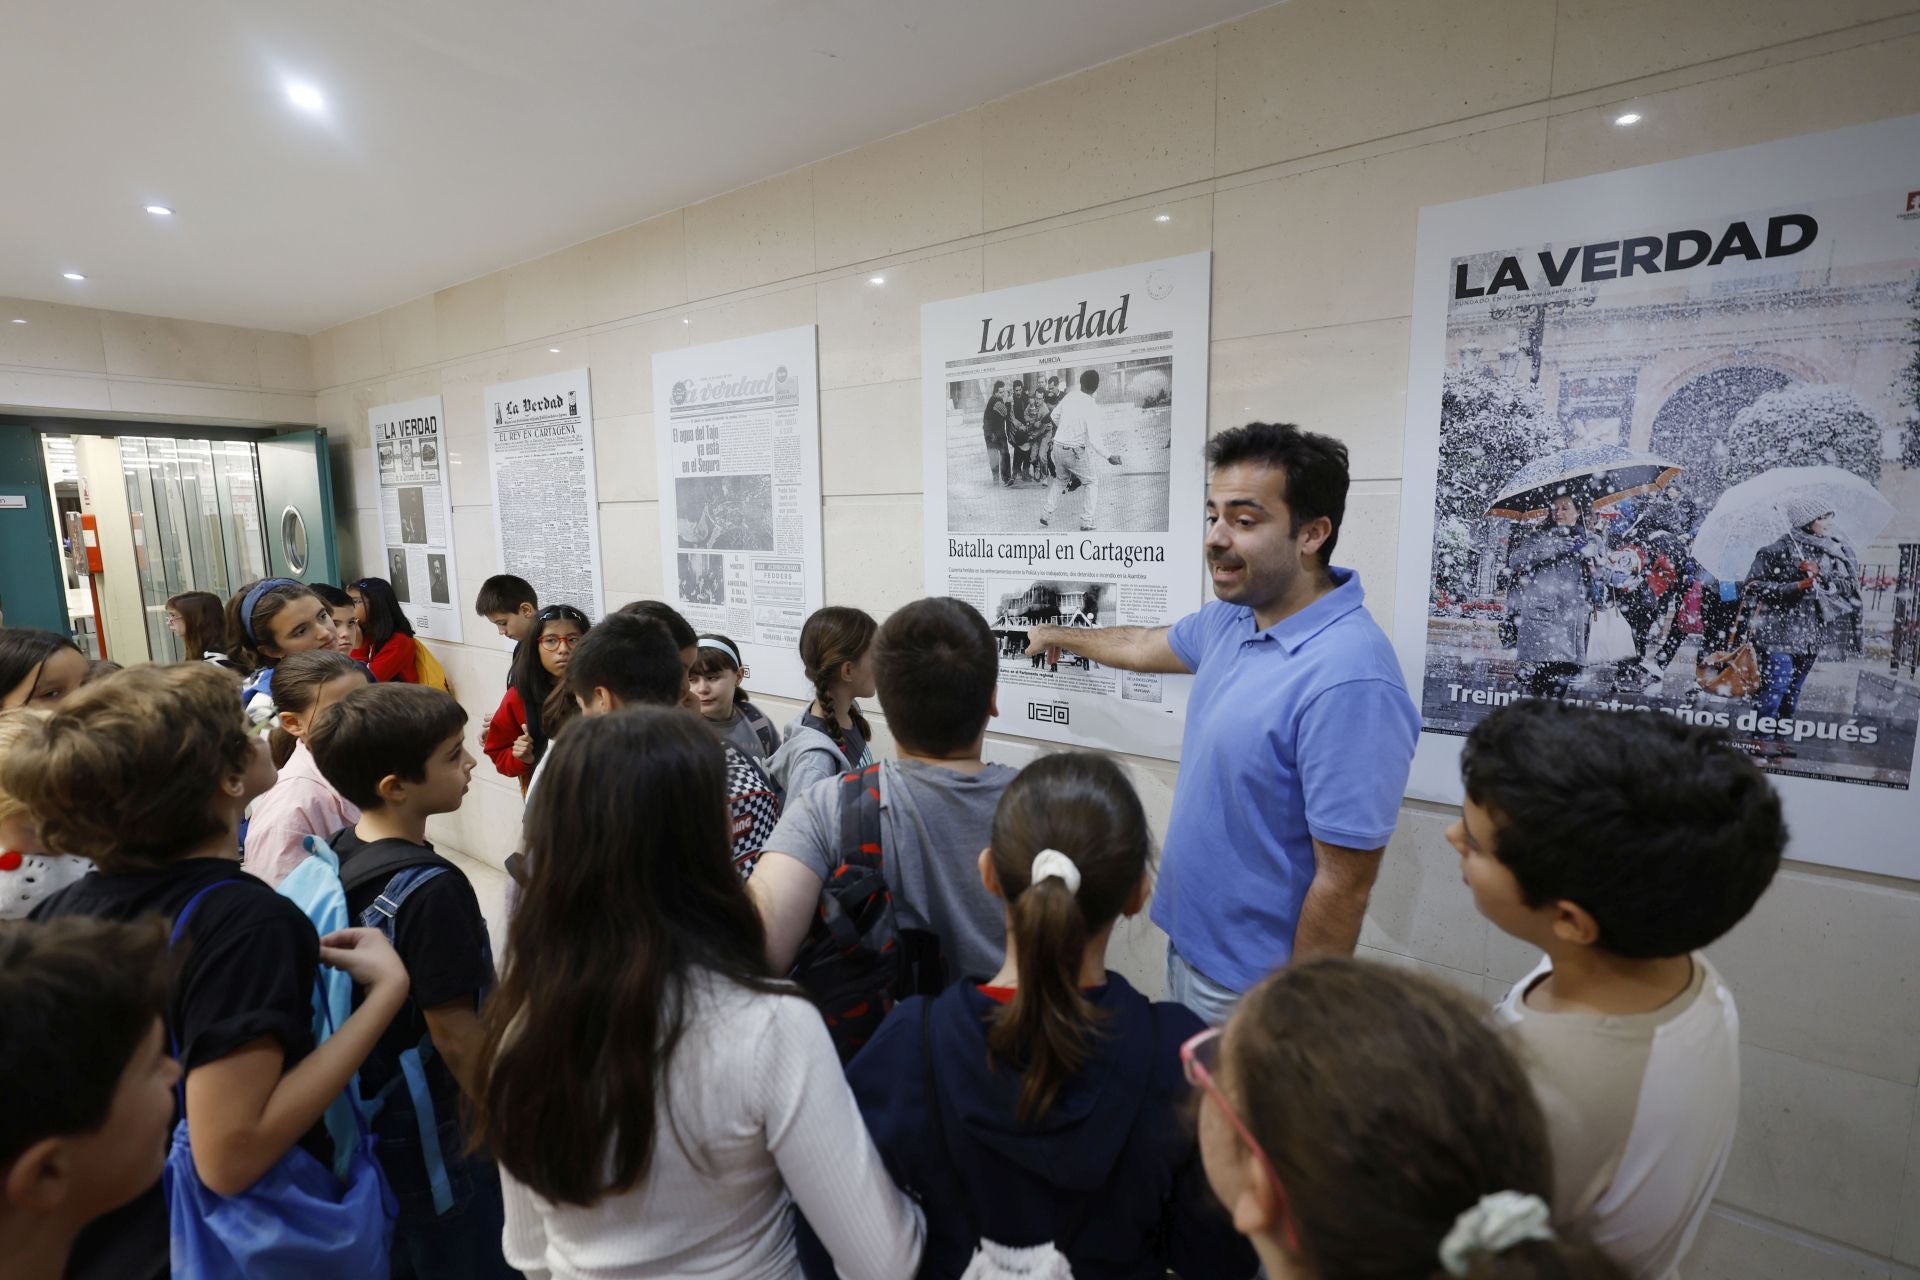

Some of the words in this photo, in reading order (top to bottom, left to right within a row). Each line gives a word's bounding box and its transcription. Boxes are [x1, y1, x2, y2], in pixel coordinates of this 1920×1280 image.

[1454, 256, 1529, 299] LA
[1537, 213, 1819, 288] VERDAD
[978, 317, 1015, 354] La
[1022, 293, 1130, 347] verdad
[1038, 356, 1061, 365] MURCIA
[700, 372, 774, 402] verdad
[506, 401, 519, 415] La
[523, 395, 564, 412] Verdad
[384, 421, 397, 439] LA
[398, 416, 437, 437] VERDAD
[499, 432, 508, 442] EL
[509, 431, 521, 441] REY
[523, 429, 532, 439] EN
[534, 424, 576, 438] CARTAGENA
[672, 427, 679, 443] El
[695, 425, 705, 441] del
[948, 538, 994, 559] Batalla
[997, 539, 1051, 566] campal
[1055, 544, 1075, 561] en
[1079, 539, 1166, 568] Cartagena
[1736, 710, 1879, 744] después
